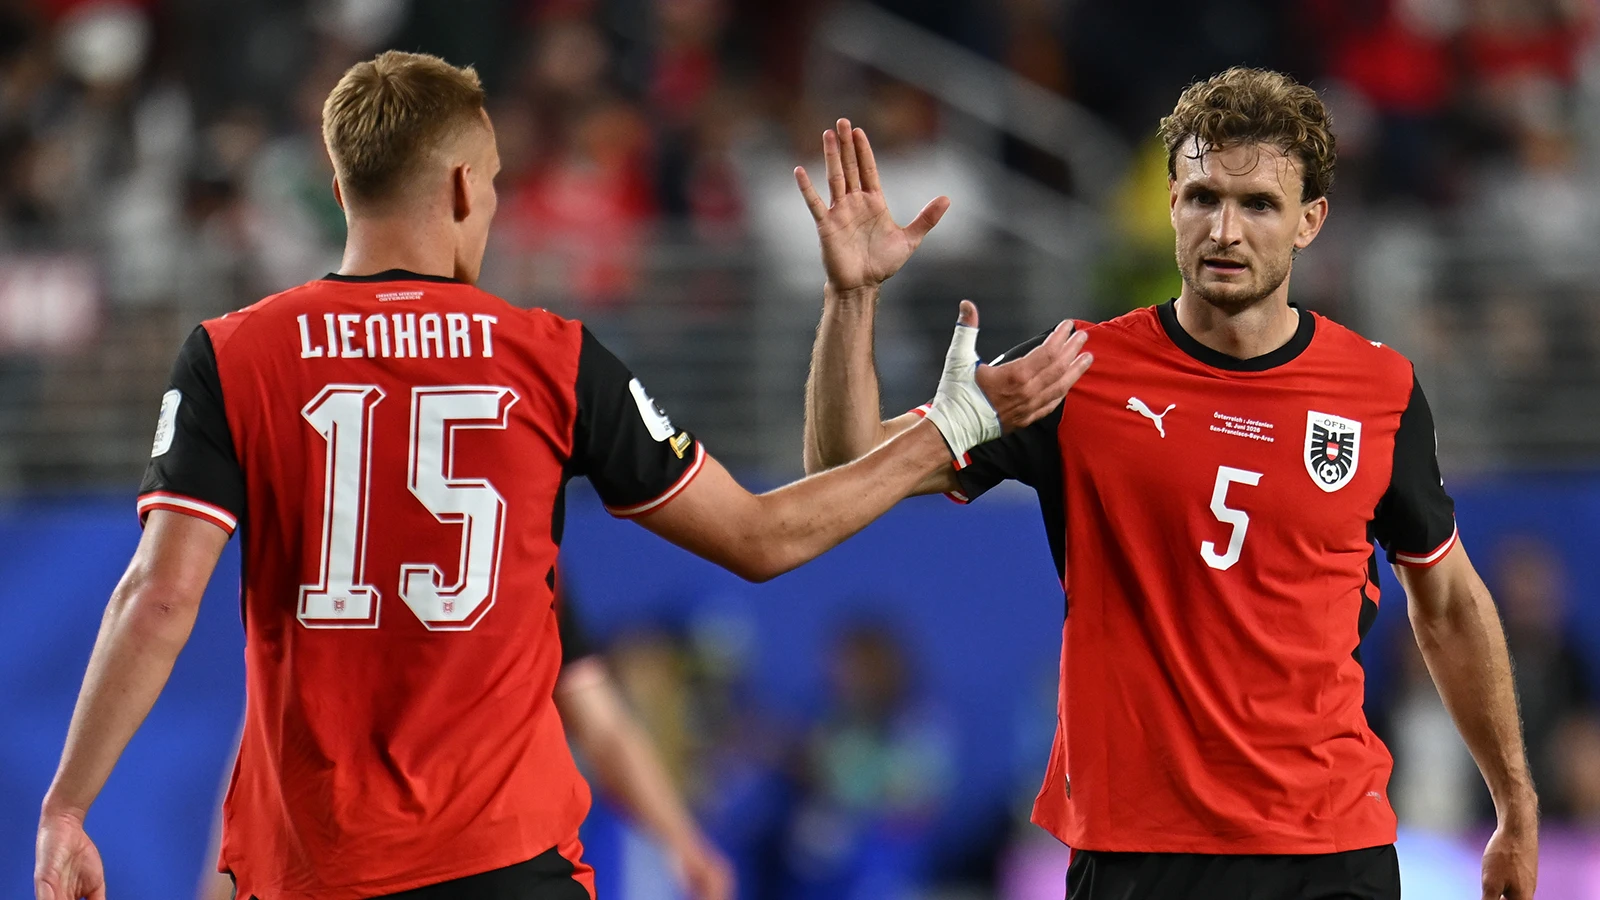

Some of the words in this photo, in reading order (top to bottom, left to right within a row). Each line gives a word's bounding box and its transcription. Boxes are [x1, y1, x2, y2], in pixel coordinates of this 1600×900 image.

[297, 313, 498, 358] LIENHART
[1246, 425, 1261, 433] 2026
[296, 384, 520, 631] 15
[1200, 465, 1265, 571] 5
